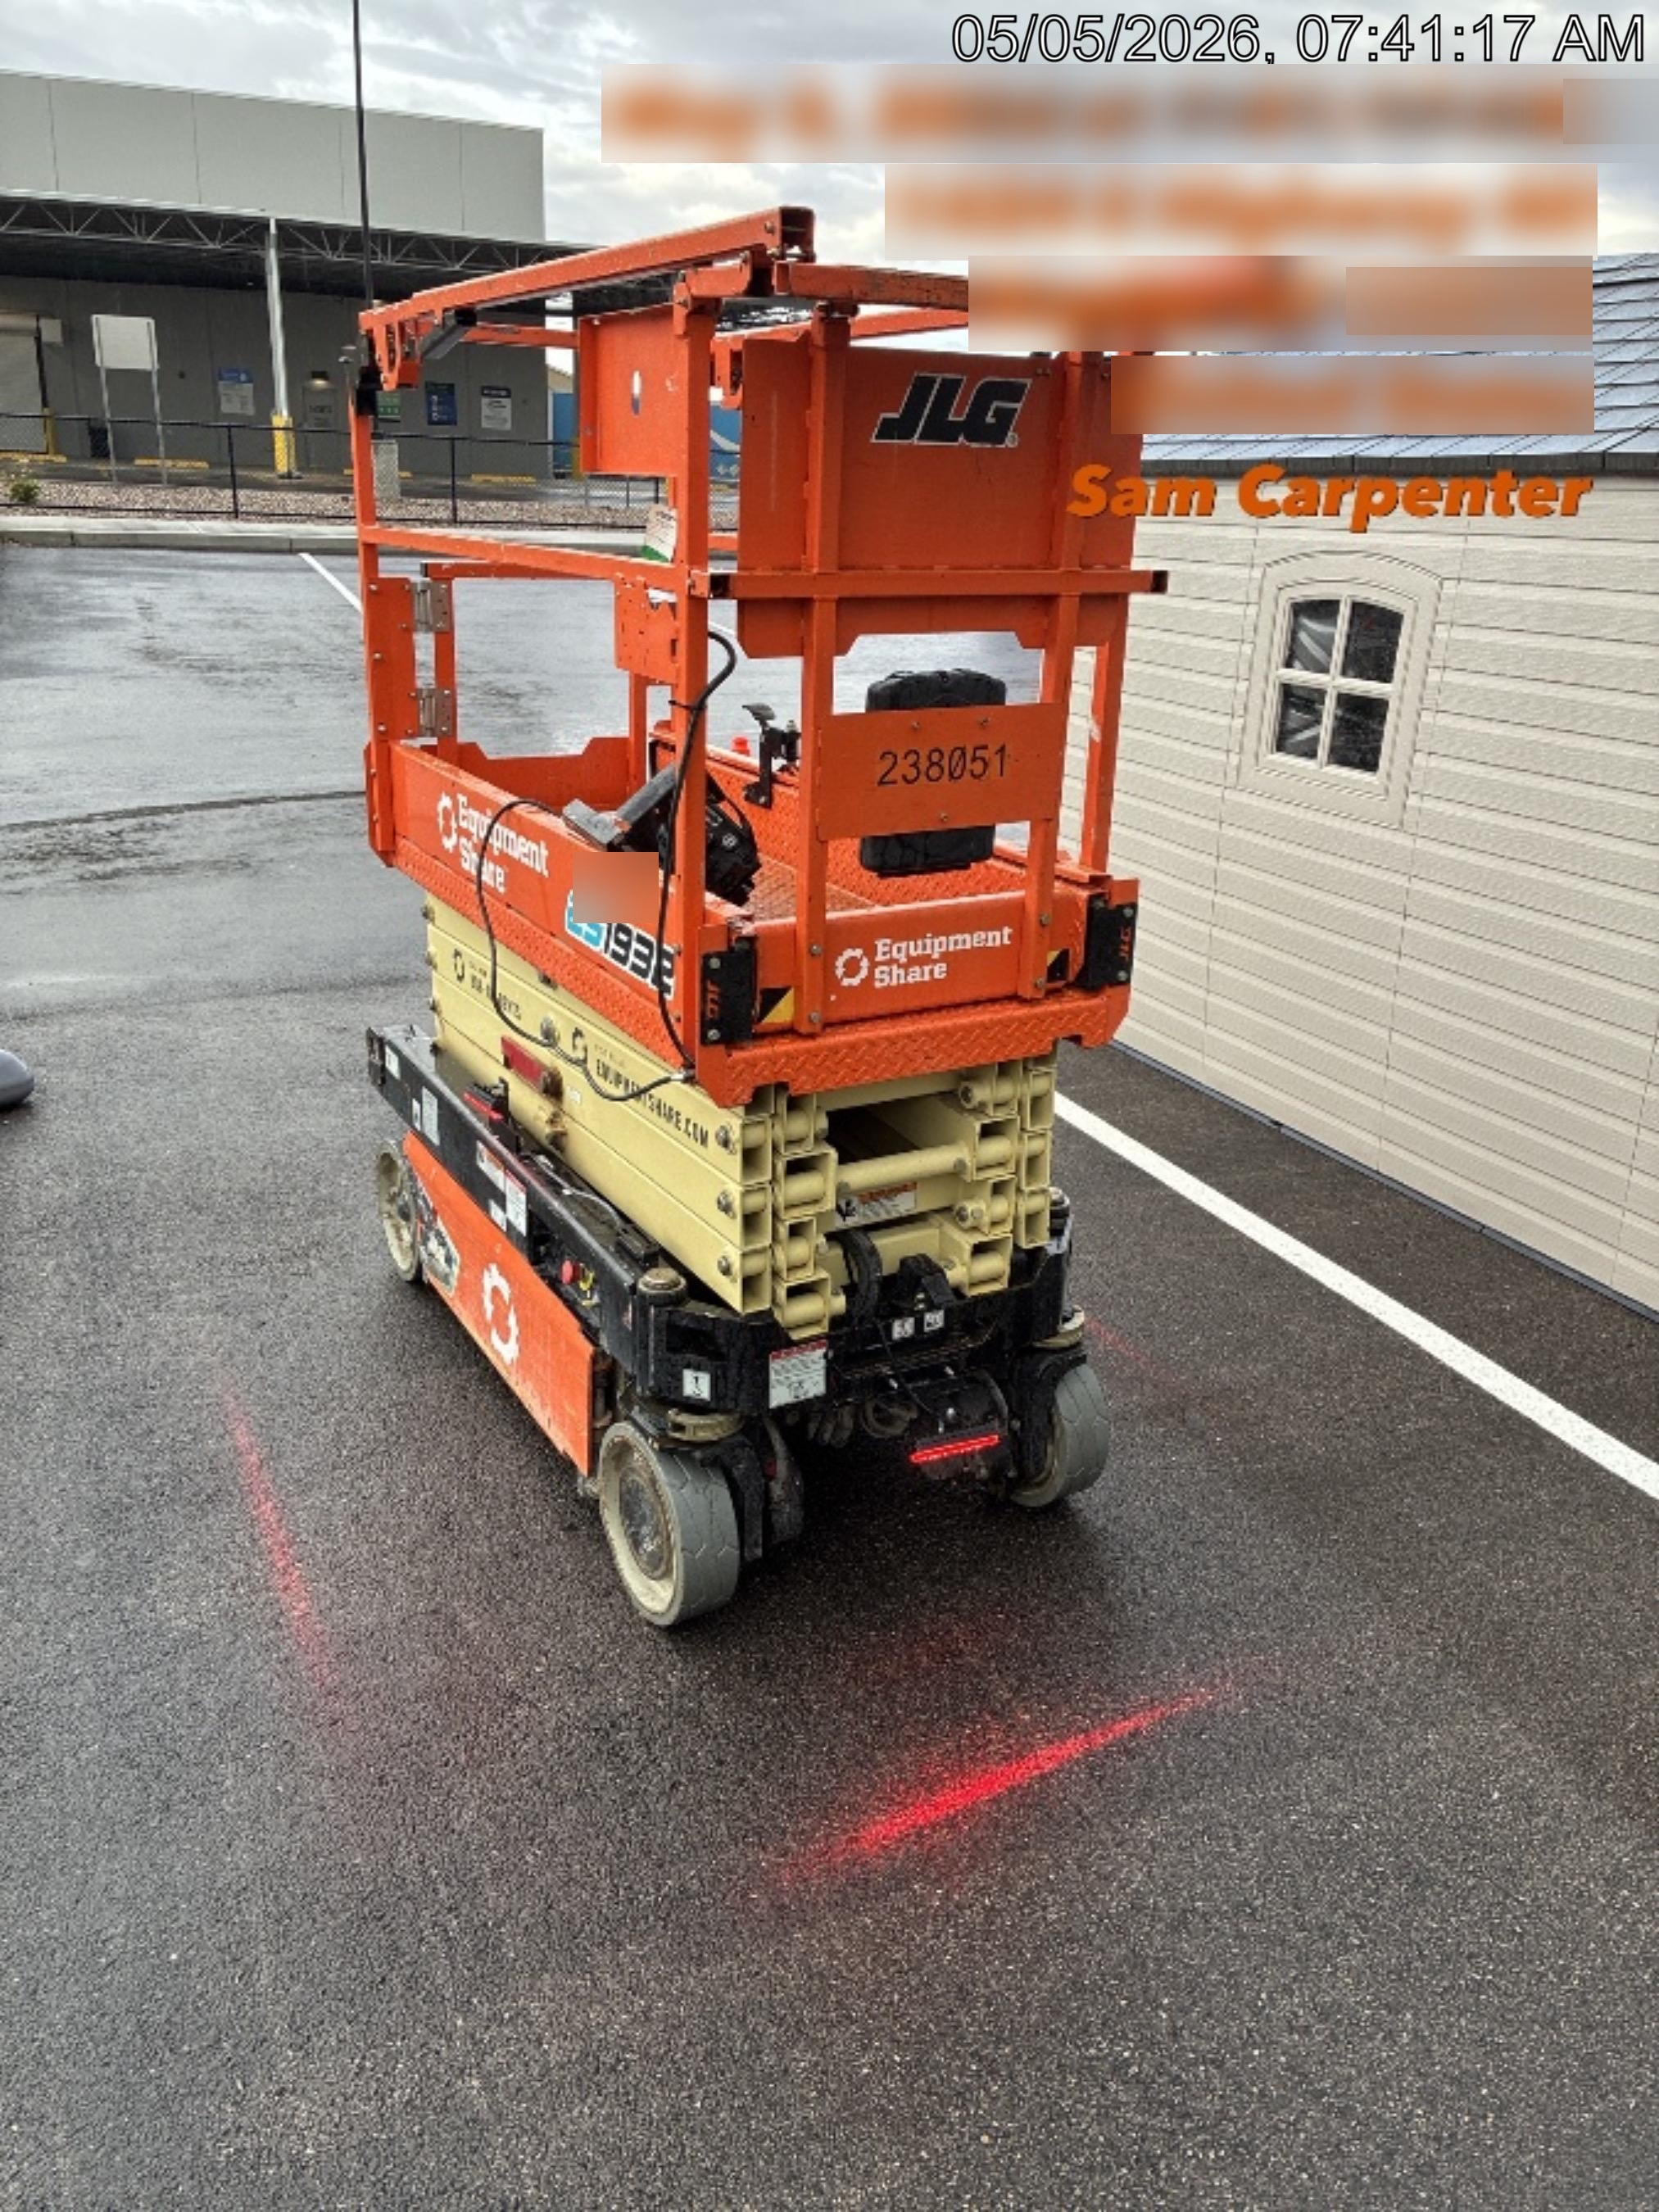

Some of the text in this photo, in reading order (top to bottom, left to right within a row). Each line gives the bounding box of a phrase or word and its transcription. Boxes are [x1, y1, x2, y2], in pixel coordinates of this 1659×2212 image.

[870, 372, 1032, 447] JLG
[877, 743, 1008, 786] 238051
[456, 793, 550, 879] Equipment
[873, 926, 1013, 963] Equipment
[873, 960, 948, 989] Share
